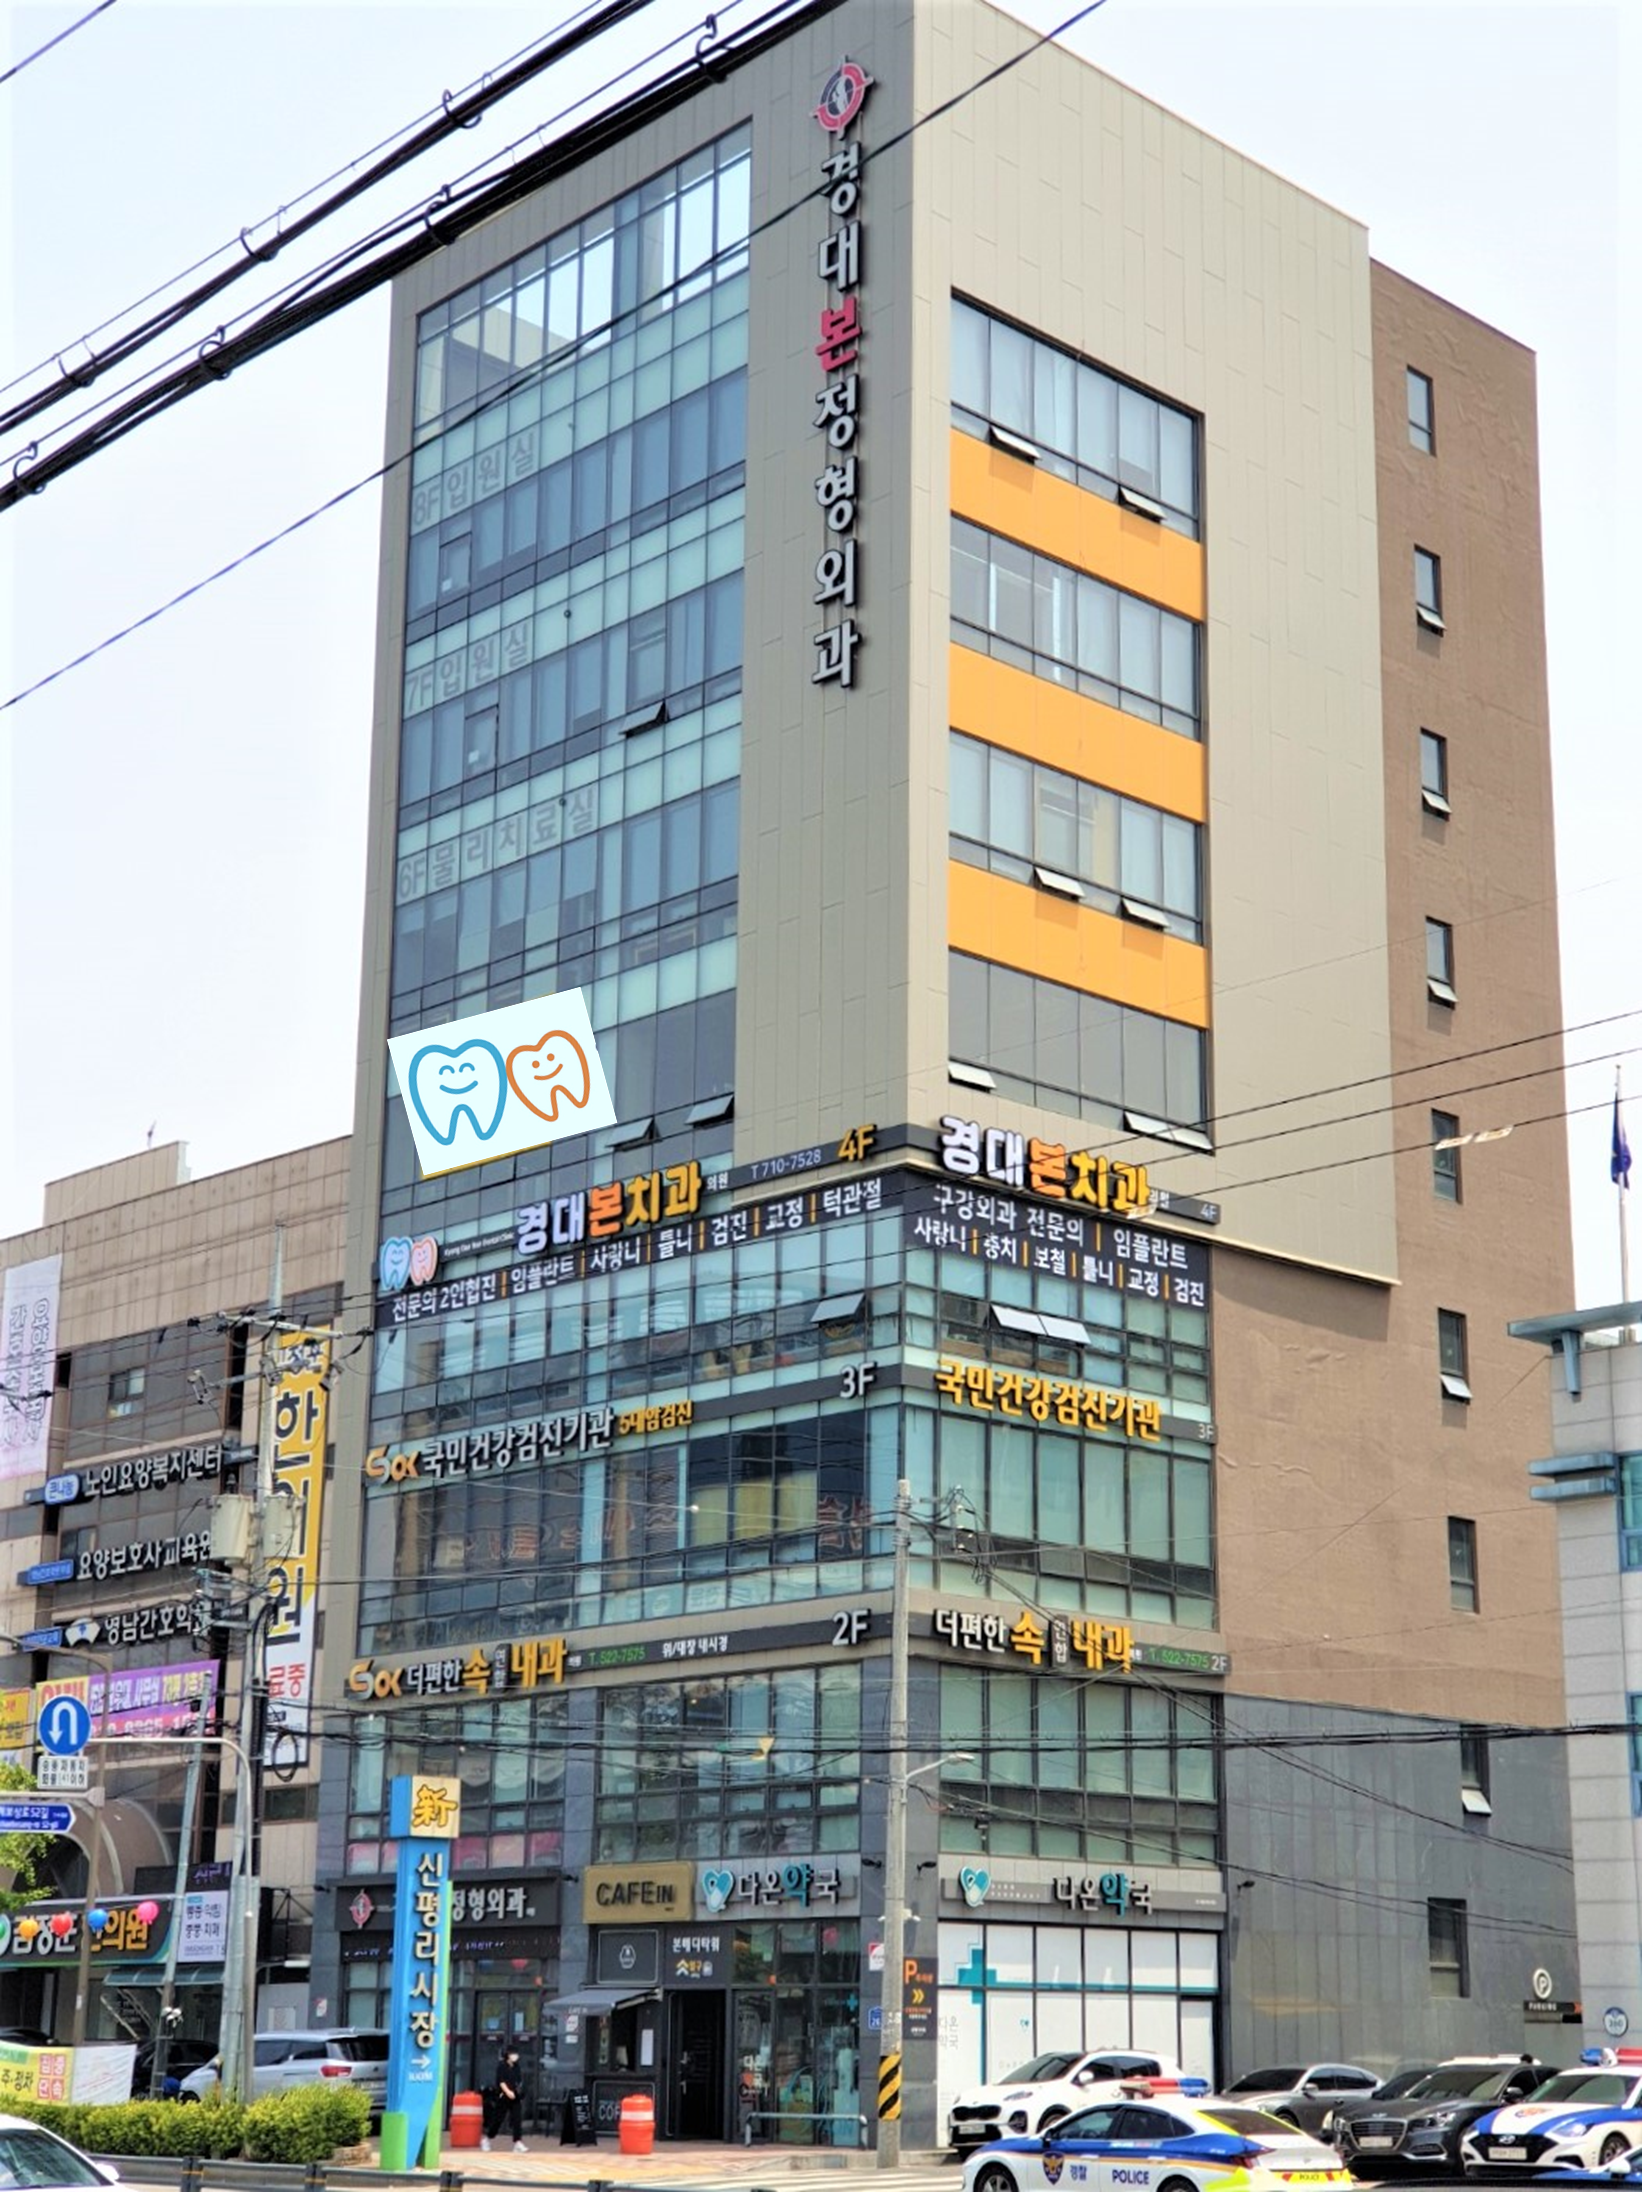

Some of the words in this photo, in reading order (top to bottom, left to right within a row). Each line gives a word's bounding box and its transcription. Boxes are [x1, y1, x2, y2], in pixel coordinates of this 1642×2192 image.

[812, 142, 863, 688] 경대본정형외과
[837, 1124, 877, 1163] 4F
[941, 1116, 1150, 1213] 경대본치과
[517, 1160, 702, 1256] 경대본치과
[765, 1199, 804, 1232] 교정
[823, 1177, 883, 1219] 턱관절
[933, 1182, 1018, 1231] 구강외과
[1026, 1206, 1084, 1247] 전문의
[1200, 1203, 1217, 1220] 4F
[658, 1223, 693, 1259] 틀니
[711, 1211, 748, 1247] 검진
[914, 1216, 966, 1252] 사랑니
[983, 1232, 1018, 1264] 충치
[590, 1236, 641, 1272] 사랑니
[1033, 1246, 1067, 1277] 보철
[1113, 1229, 1189, 1270] 임플란트
[511, 1255, 575, 1296] 임플란트
[1082, 1255, 1115, 1287] 틀니
[1127, 1268, 1160, 1298] 교정
[392, 1285, 437, 1323] 전문의
[439, 1274, 497, 1311] 2인협진
[1173, 1277, 1205, 1308] 검진
[839, 1361, 876, 1398] 3F
[935, 1358, 1163, 1442] 국민건강검진기관
[423, 1408, 615, 1478] 국민건강검진기관
[618, 1400, 694, 1436] 5대암검진
[1198, 1423, 1214, 1440] 3F
[84, 1444, 223, 1497] 노인요양복지센터
[830, 1609, 871, 1648] 2F
[1071, 1618, 1135, 1675] 내과
[511, 1636, 568, 1688] 내과
[697, 1634, 729, 1654] 내시경
[1211, 1656, 1228, 1672] 2F
[411, 1784, 458, 1829] 新
[737, 1863, 840, 1907] 다온약국
[1052, 1873, 1153, 1916] 다온약국
[409, 1851, 445, 2050] 신평리시장
[904, 1960, 918, 1985] P
[1070, 2164, 1088, 2182] 경찰
[1111, 2168, 1150, 2186] POLICE
